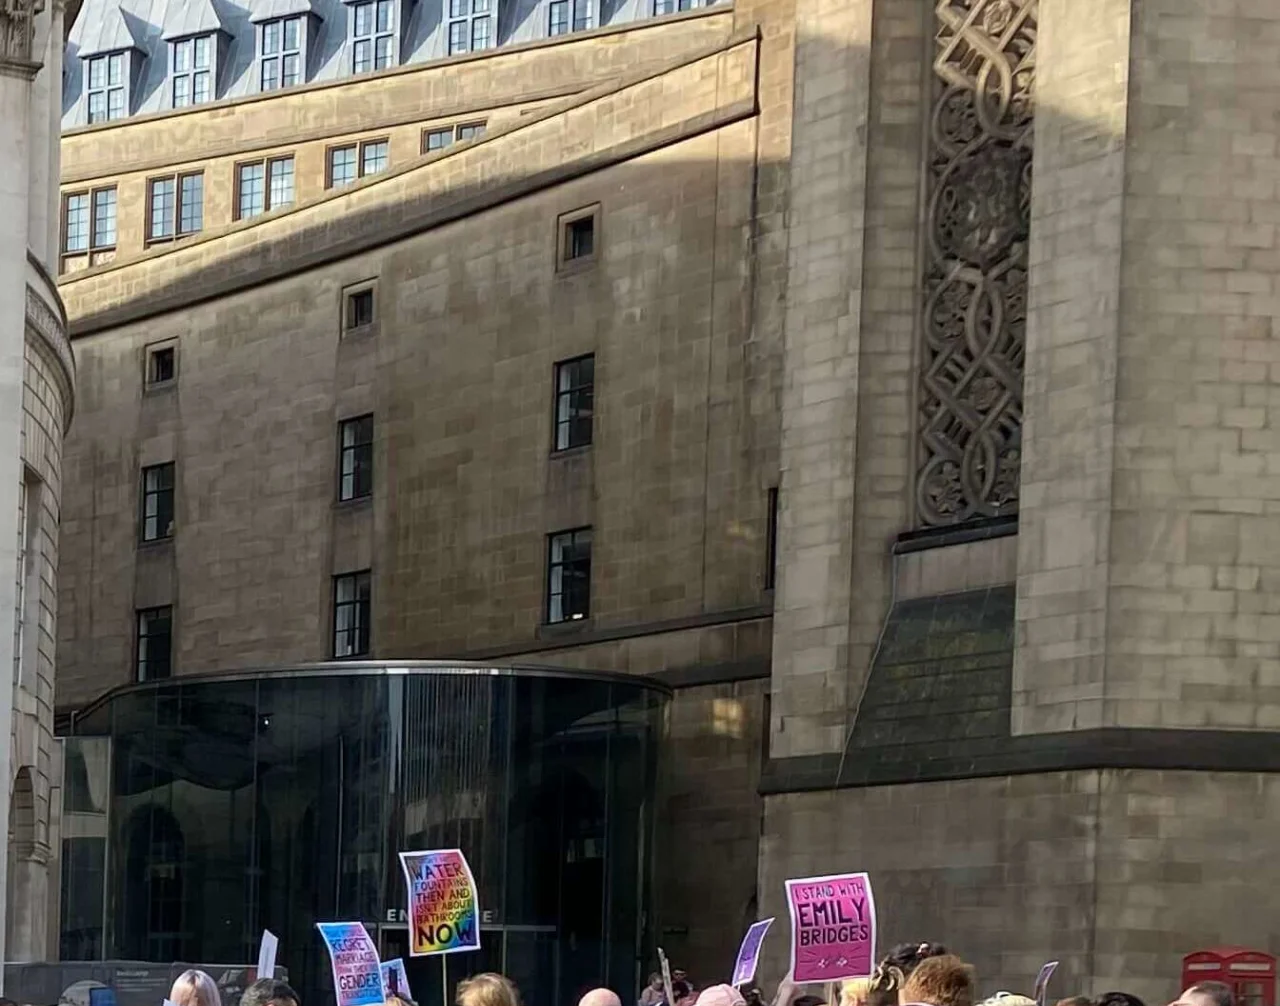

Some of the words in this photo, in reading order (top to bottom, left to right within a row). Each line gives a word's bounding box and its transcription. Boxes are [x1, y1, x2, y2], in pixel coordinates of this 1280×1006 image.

[411, 863, 464, 881] WATER
[414, 877, 468, 892] FOUNTAINS
[795, 889, 800, 899] I
[804, 885, 834, 900] STAND
[840, 882, 864, 897] WITH
[416, 891, 444, 903] THEN
[450, 887, 470, 900] AND
[443, 900, 471, 910] ABOUT
[797, 898, 865, 927] EMILY
[418, 921, 472, 946] NOW
[800, 925, 868, 946] BRIDGES
[340, 972, 382, 990] GENDER
